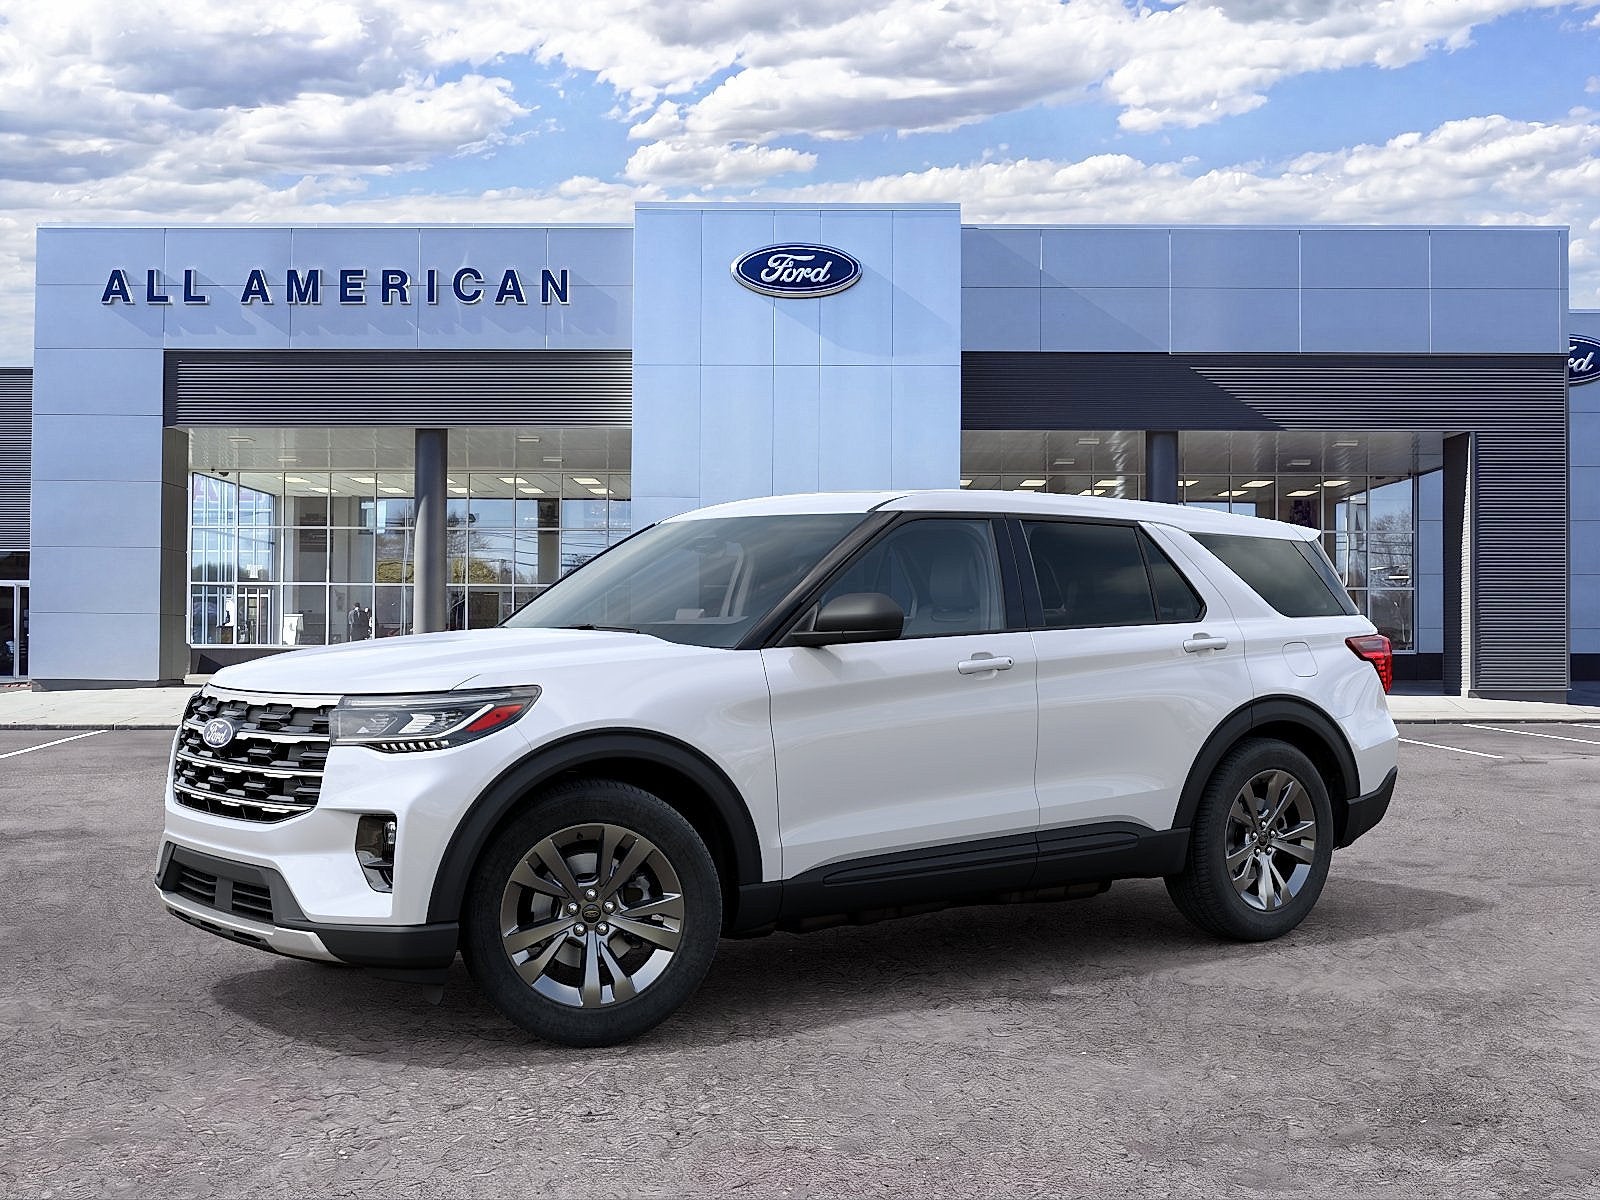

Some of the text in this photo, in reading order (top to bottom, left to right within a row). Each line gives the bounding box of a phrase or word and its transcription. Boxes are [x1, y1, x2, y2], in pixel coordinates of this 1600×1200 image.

[760, 253, 833, 283] Ford
[101, 267, 571, 305] ALL AMERICAN
[205, 721, 229, 744] Ford
